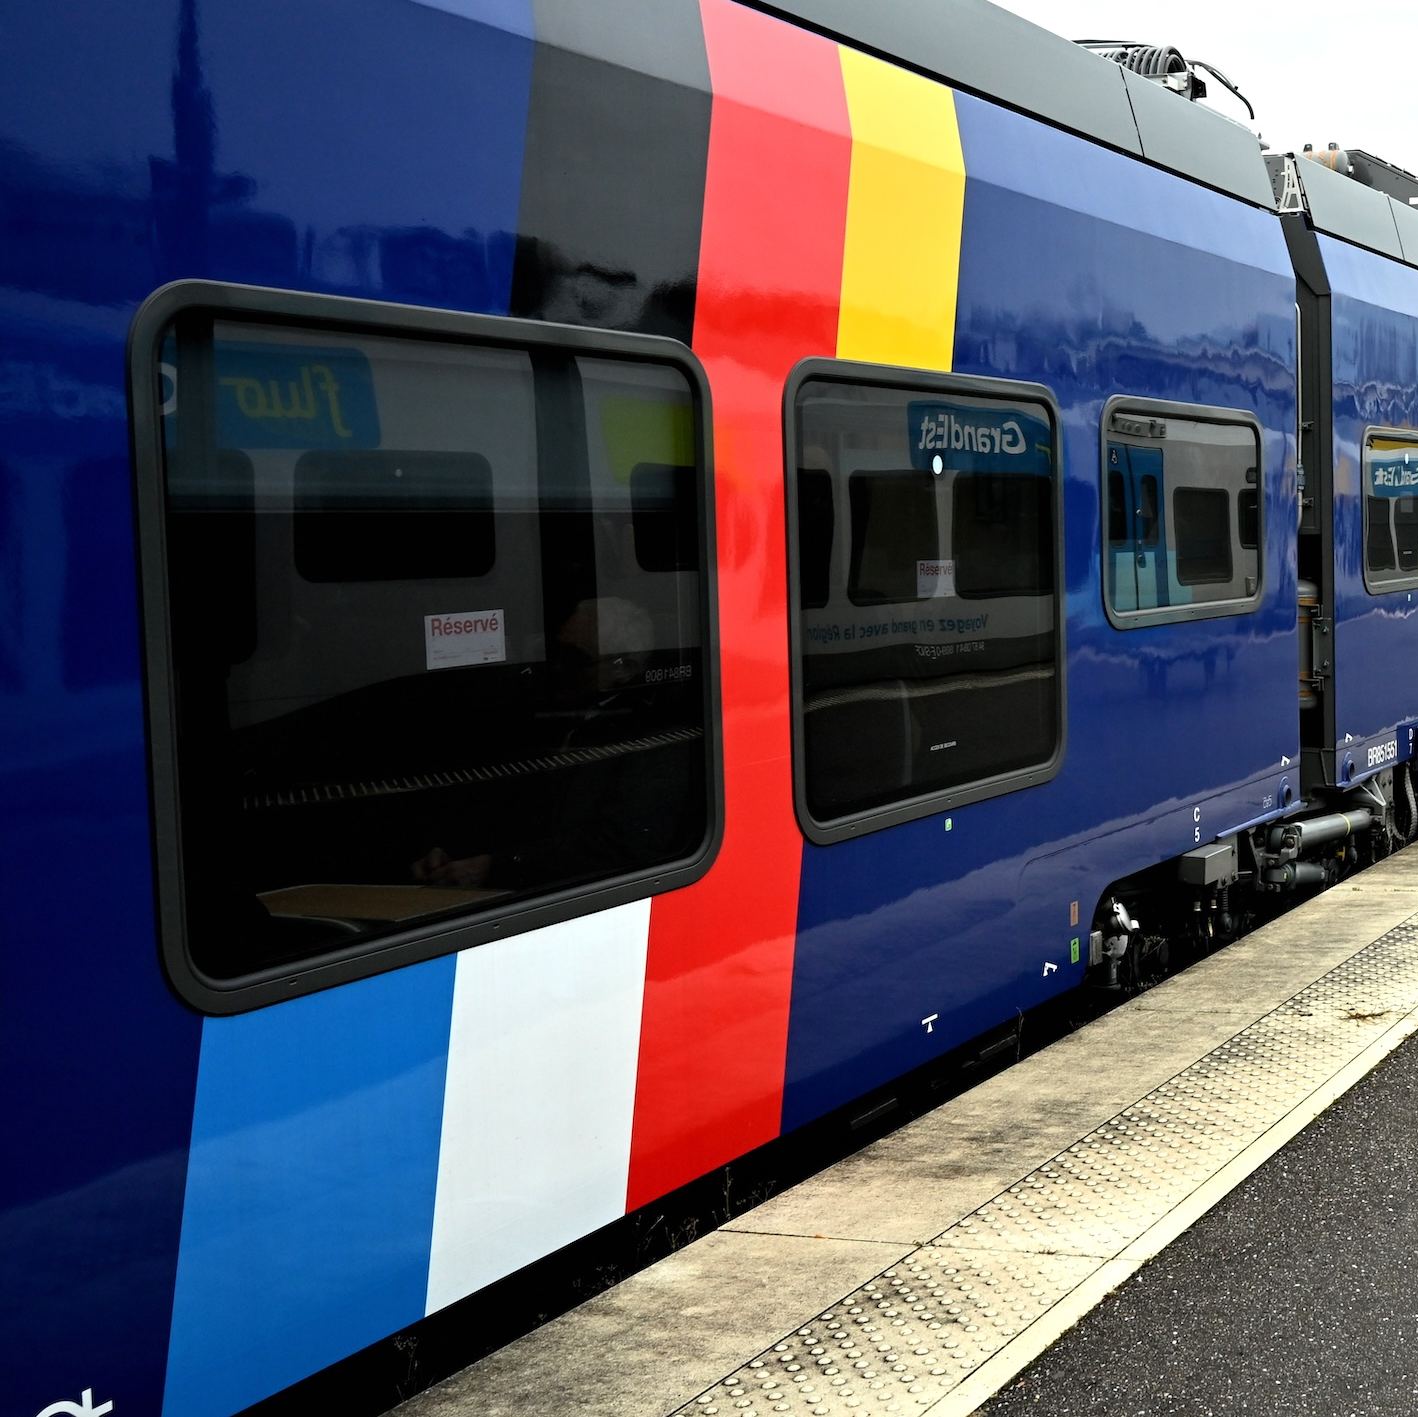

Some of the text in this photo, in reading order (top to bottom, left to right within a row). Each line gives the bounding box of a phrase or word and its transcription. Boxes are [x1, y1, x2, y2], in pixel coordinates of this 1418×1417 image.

[919, 561, 953, 576] Réservé
[430, 612, 499, 637] Réservé
[1367, 739, 1398, 767] BR851551
[1193, 806, 1200, 822] C
[1194, 826, 1200, 842] 5
